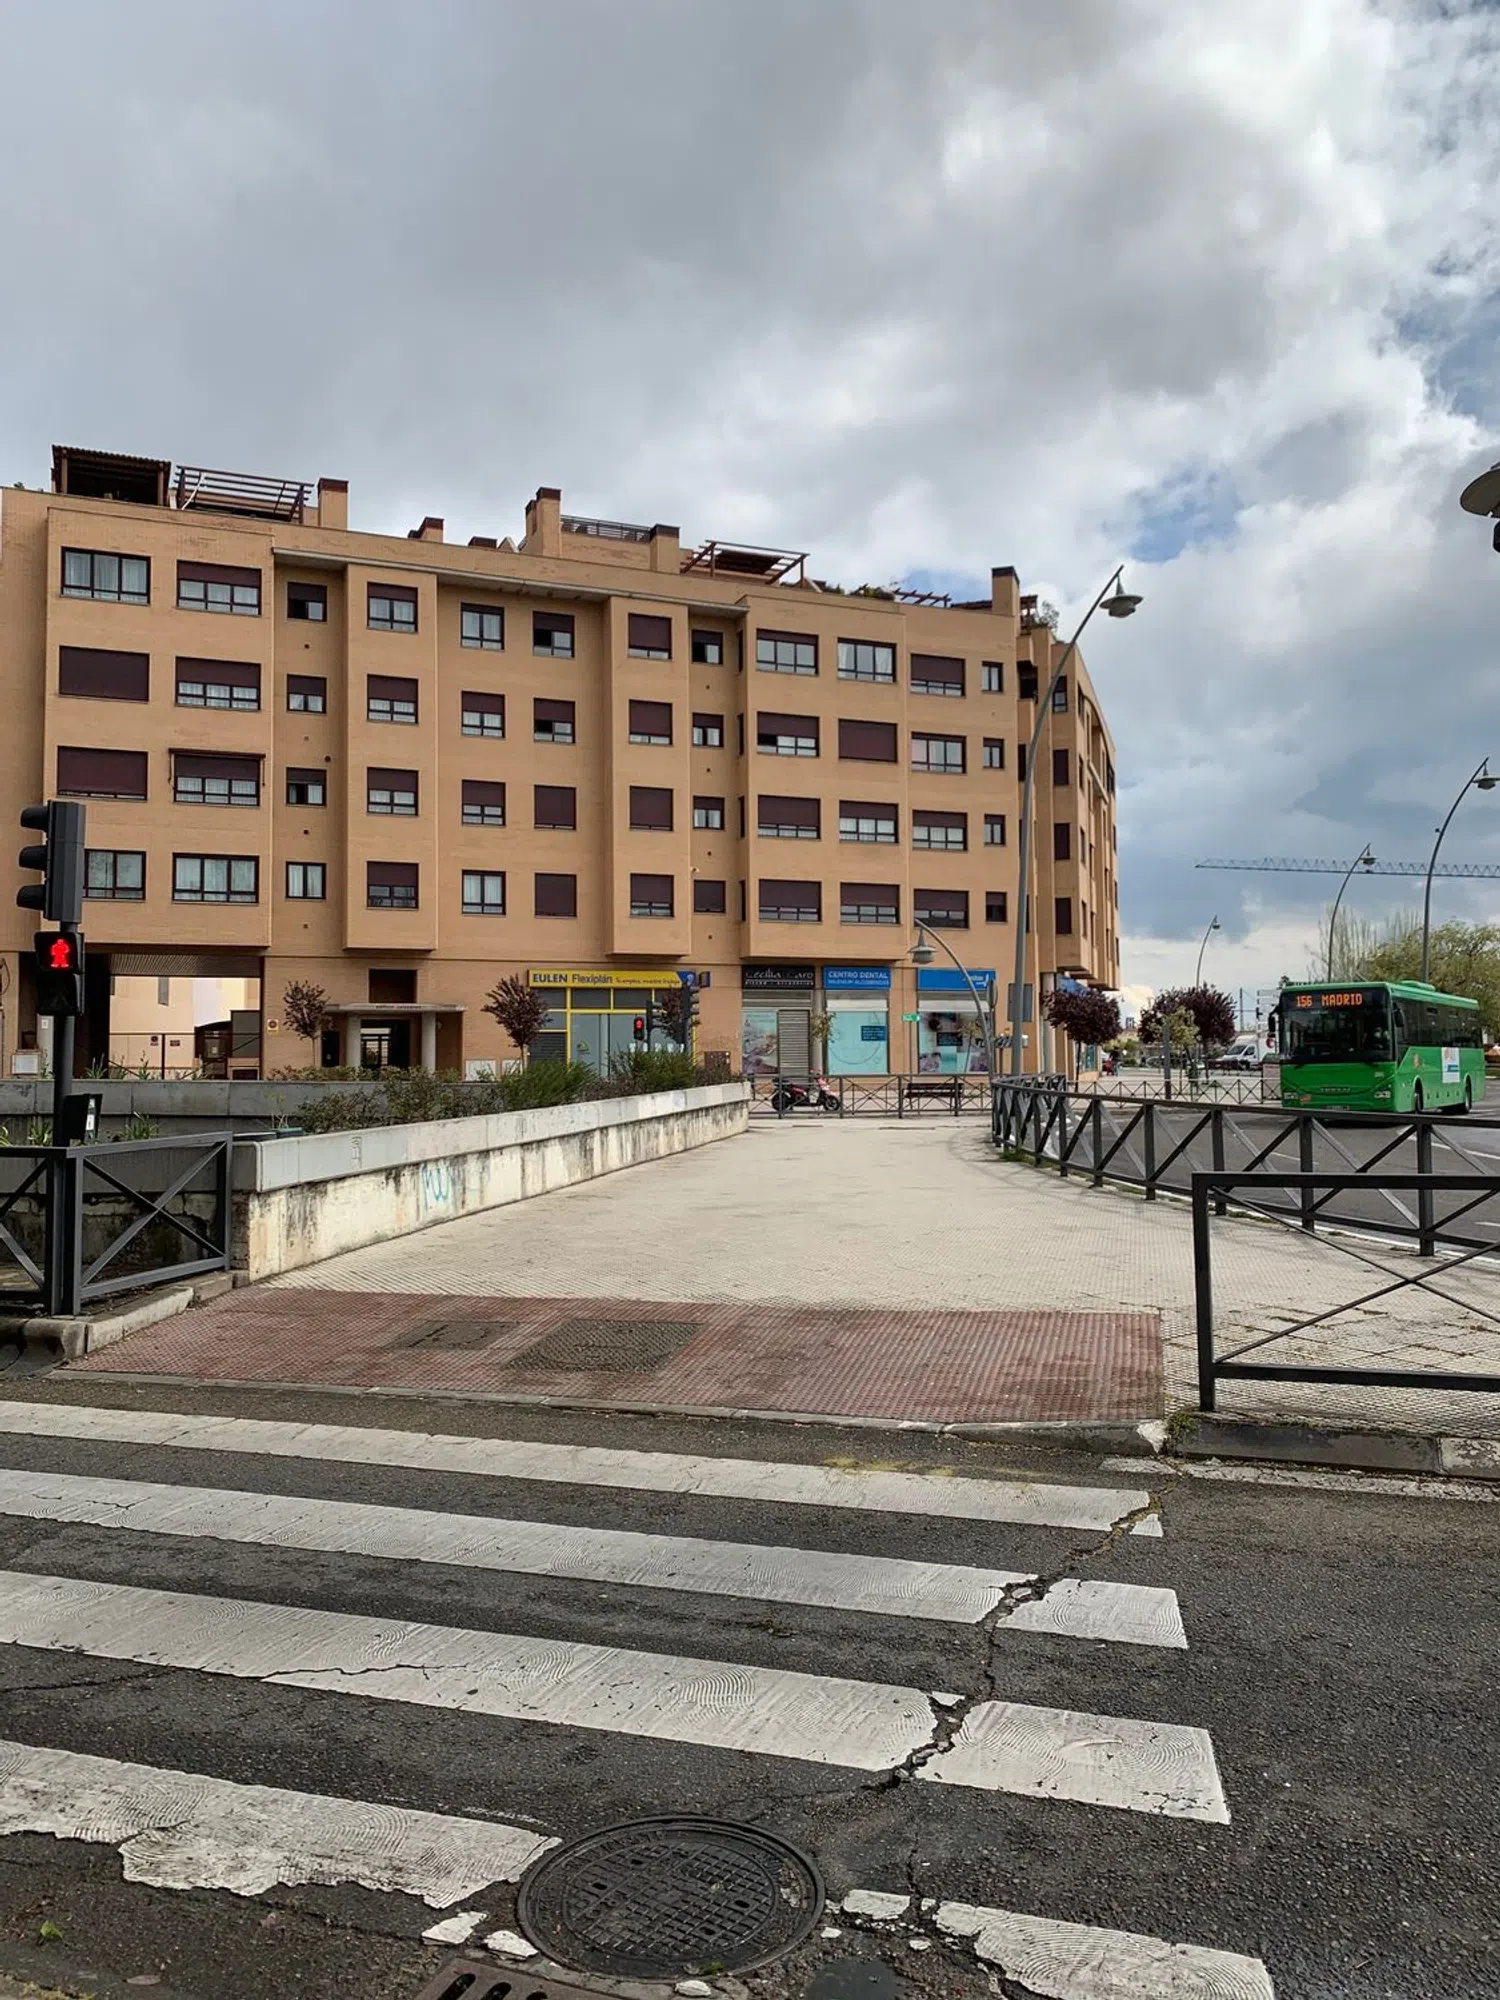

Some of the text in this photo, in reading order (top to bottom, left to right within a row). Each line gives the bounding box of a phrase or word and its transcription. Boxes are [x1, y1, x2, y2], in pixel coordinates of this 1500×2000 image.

[532, 972, 613, 985] EULEN Flexiplán
[827, 970, 889, 980] CENTRO DENTAL
[1296, 992, 1363, 1008] 156 MADRID
